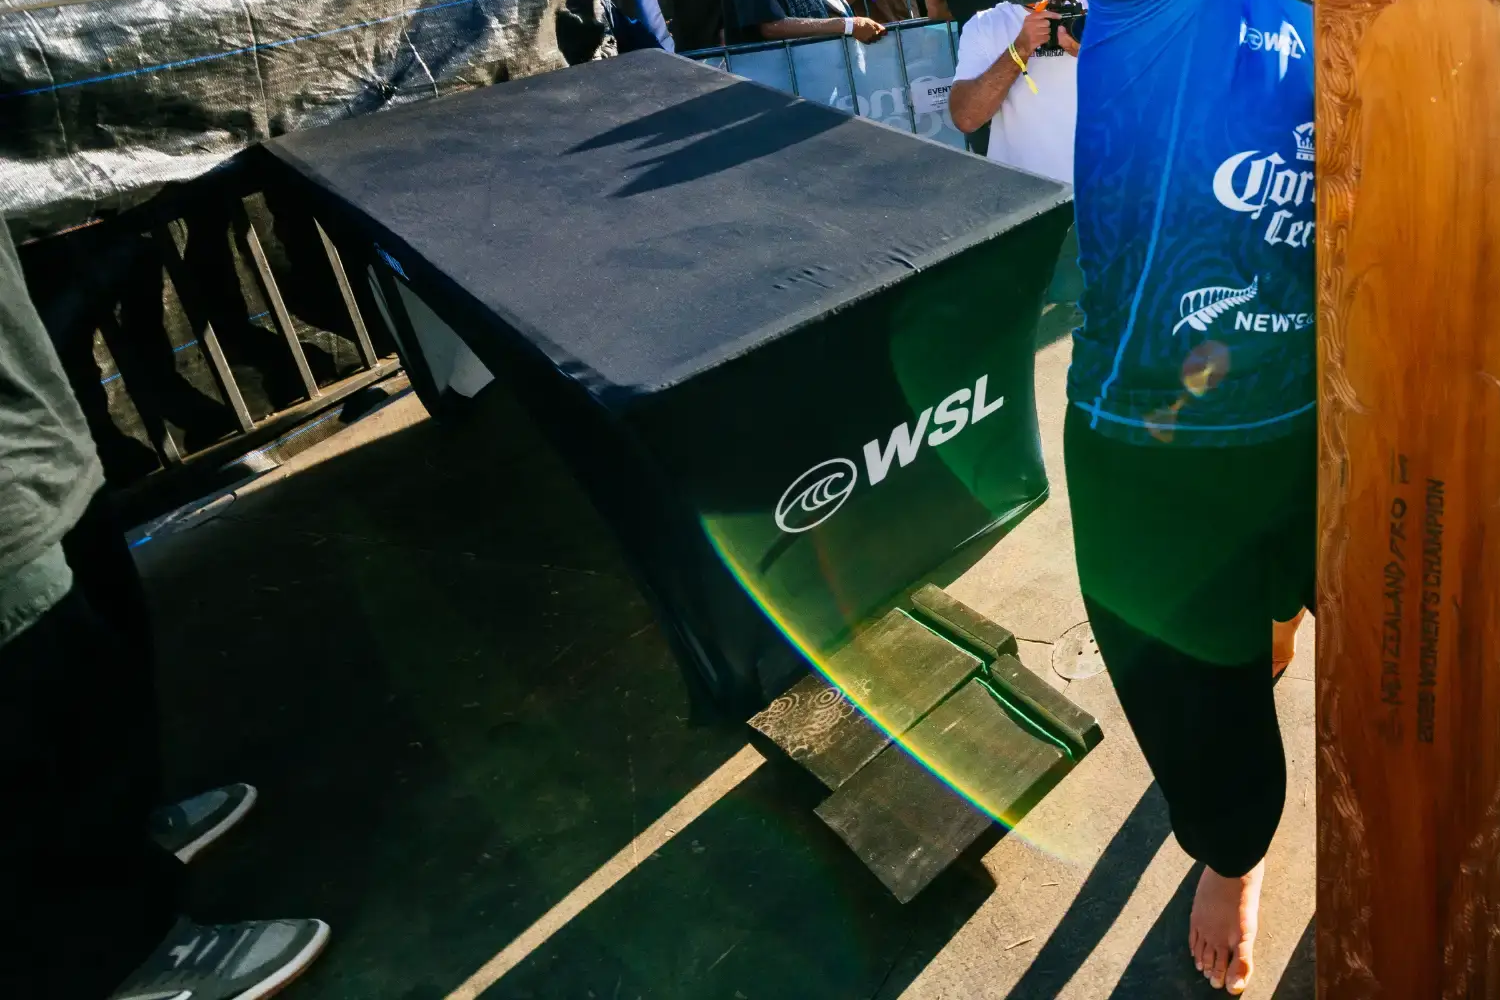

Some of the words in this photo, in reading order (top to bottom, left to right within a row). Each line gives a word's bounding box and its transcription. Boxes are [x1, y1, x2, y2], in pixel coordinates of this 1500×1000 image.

[1213, 150, 1315, 220] Cor
[1264, 209, 1315, 247] Cer
[1235, 311, 1289, 333] NEW
[863, 374, 1004, 486] WSL
[1422, 477, 1446, 588] CHAMPION
